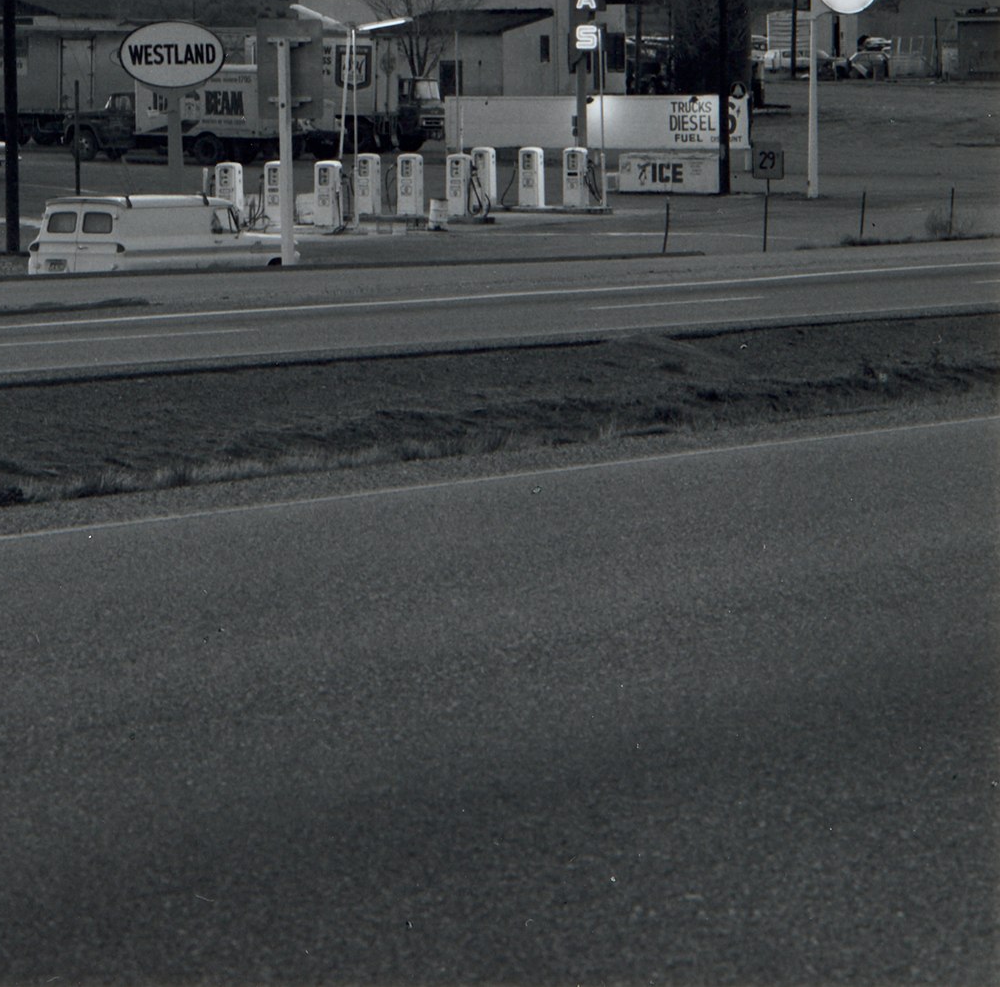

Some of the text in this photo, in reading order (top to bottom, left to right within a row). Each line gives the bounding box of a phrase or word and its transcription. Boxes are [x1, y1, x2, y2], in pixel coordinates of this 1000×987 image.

[128, 43, 216, 66] WESTLAND
[205, 90, 245, 116] BEAM
[670, 101, 713, 114] TRUCKS
[669, 115, 716, 132] DIESEL
[674, 133, 704, 143] FUEL
[759, 150, 776, 171] 29
[651, 162, 684, 183] ICE
